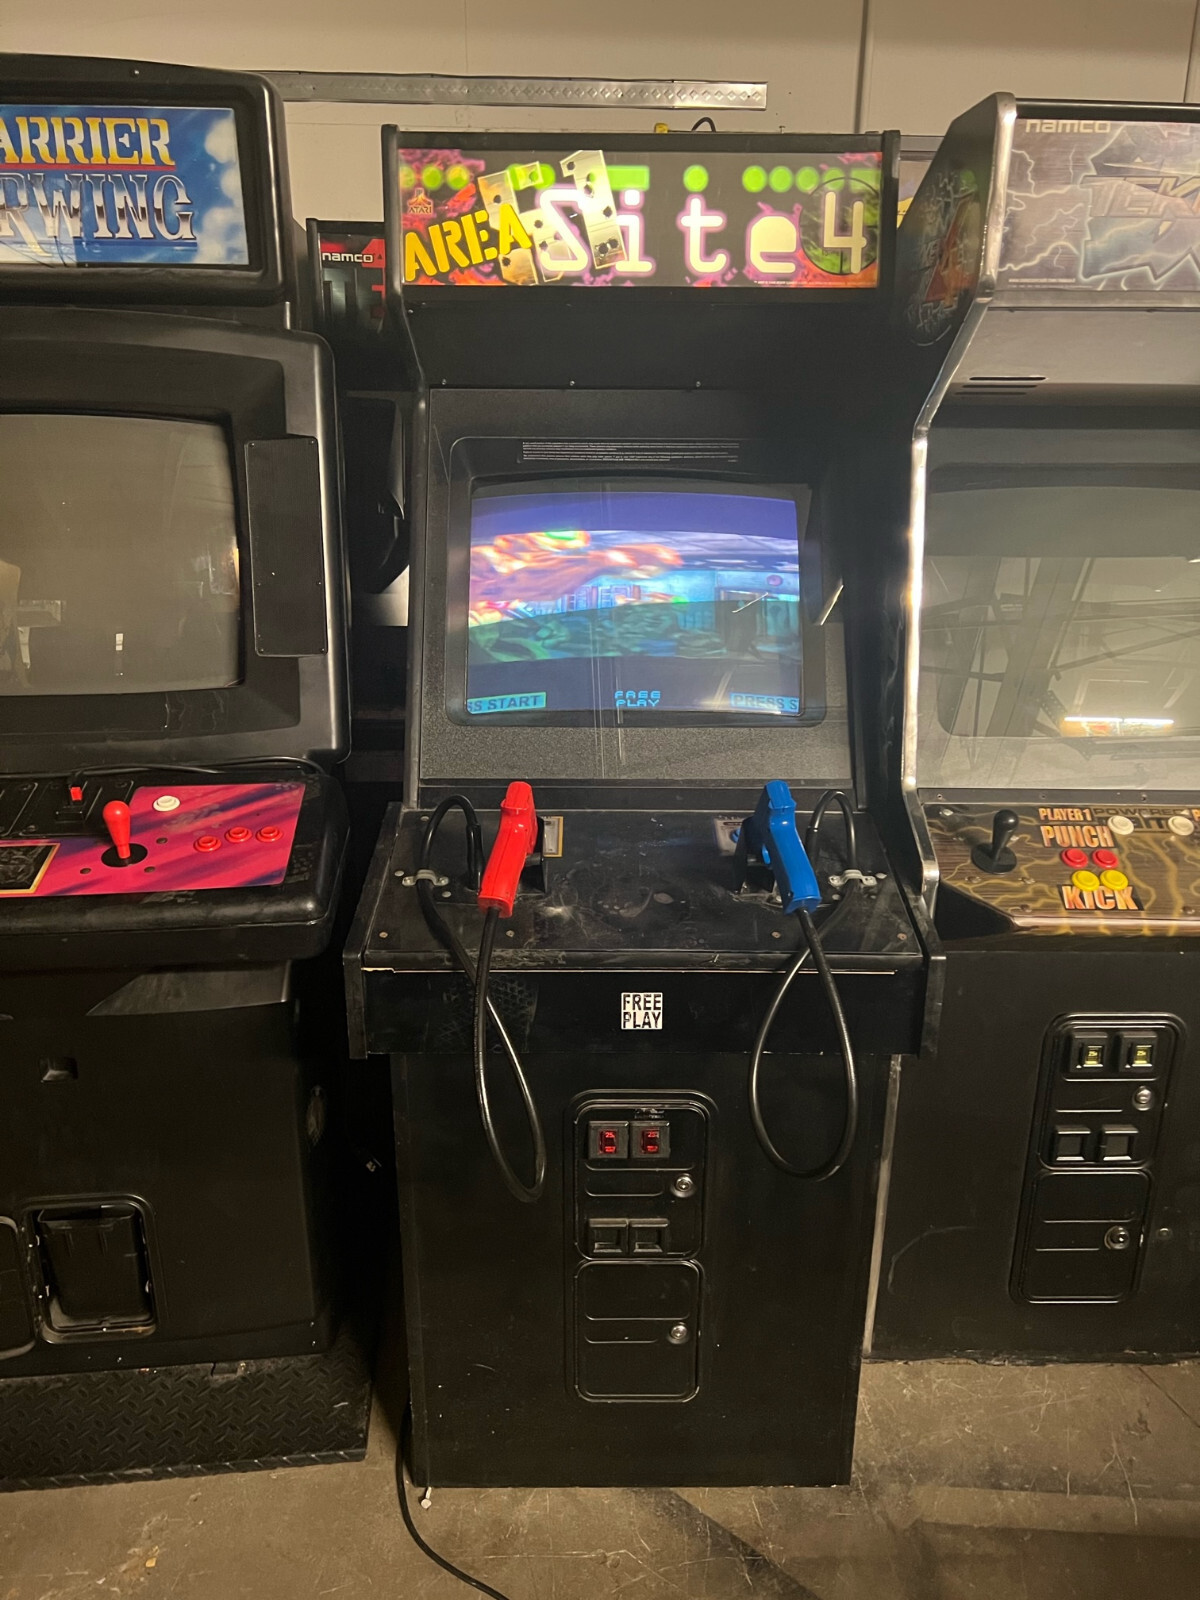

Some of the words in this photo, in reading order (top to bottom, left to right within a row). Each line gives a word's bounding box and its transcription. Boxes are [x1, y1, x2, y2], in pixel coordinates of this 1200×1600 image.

[1025, 119, 1111, 133] namco
[408, 206, 432, 214] ATARI
[539, 187, 797, 273] Site
[824, 192, 867, 274] 4
[405, 203, 532, 282] AREA
[322, 252, 373, 262] namco
[487, 695, 540, 710] START
[615, 691, 661, 699] FREE
[733, 694, 784, 709] PRESS
[616, 699, 660, 707] PLAY
[1038, 807, 1083, 821] PLAYER
[1082, 808, 1092, 821] 1
[1040, 825, 1115, 847] PUNCH
[1061, 885, 1139, 910] KICK
[623, 994, 662, 1010] FREE
[623, 1012, 661, 1028] PLAY
